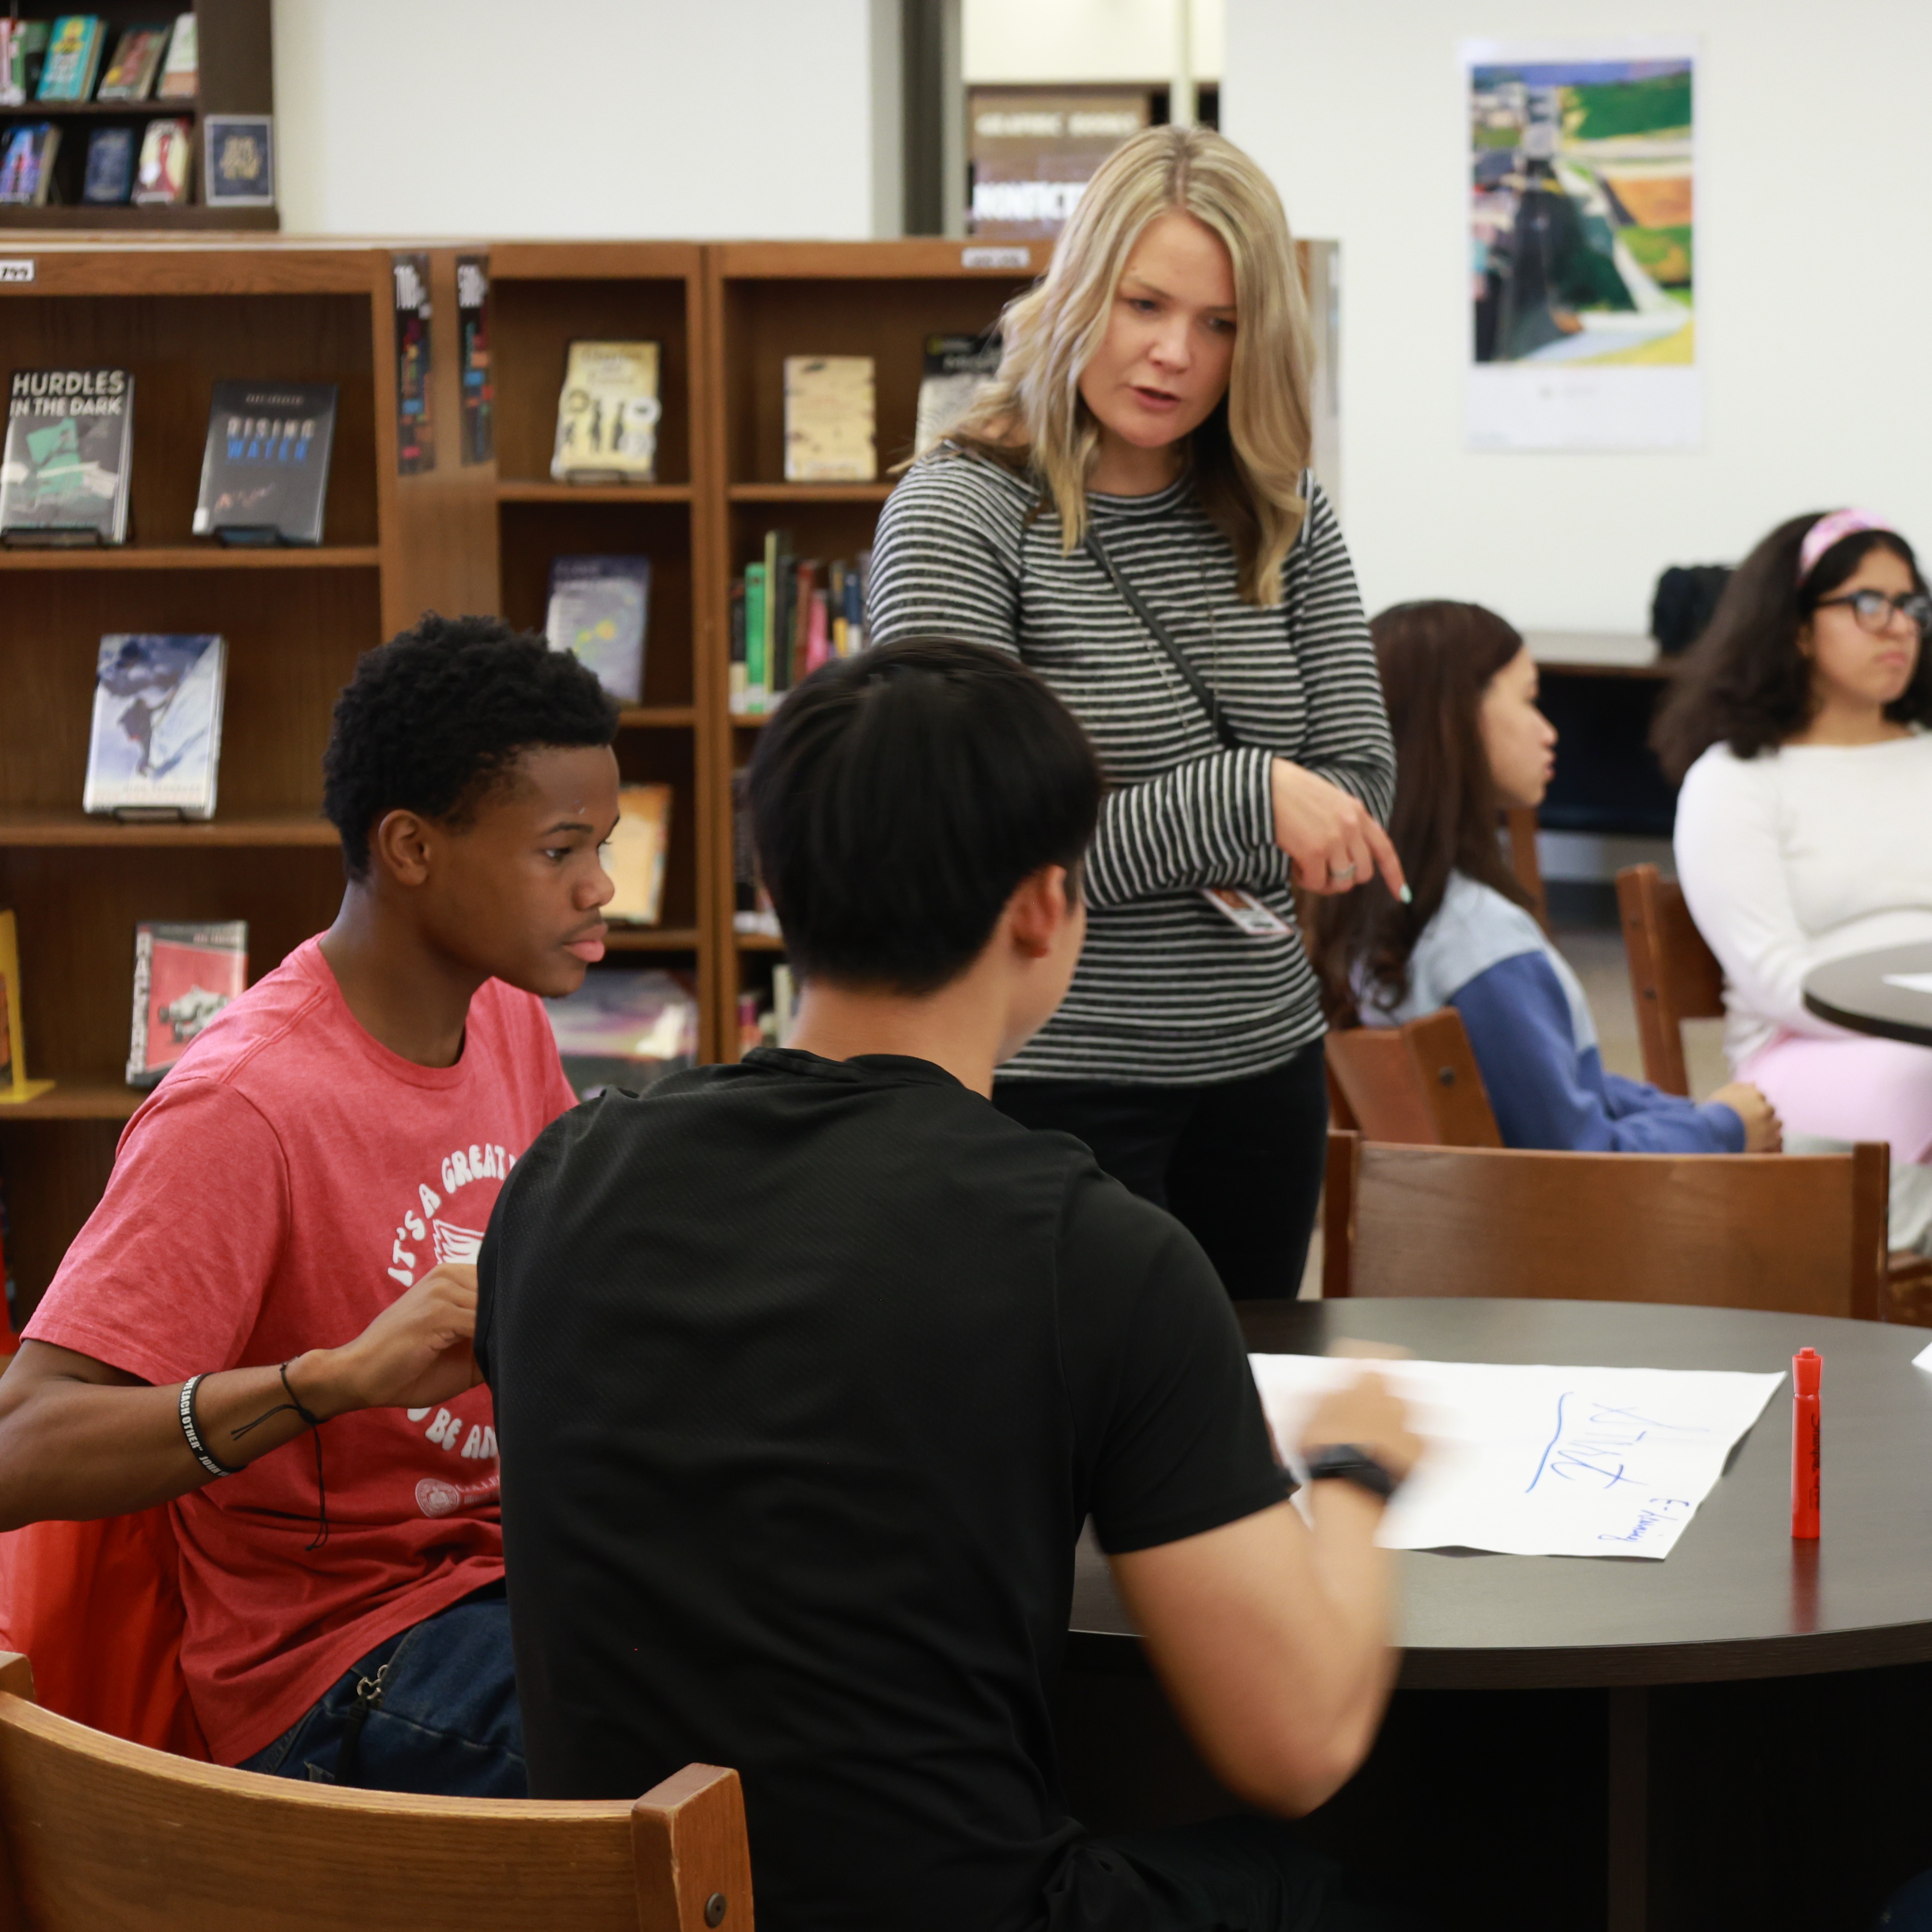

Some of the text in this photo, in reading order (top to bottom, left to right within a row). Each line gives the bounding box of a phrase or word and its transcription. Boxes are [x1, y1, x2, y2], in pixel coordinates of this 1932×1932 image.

[12, 370, 125, 397] HURDLES
[10, 395, 123, 417] IN THE DARK
[388, 1143, 505, 1287] IT'S A GREAT
[180, 1390, 191, 1416] EACH
[199, 1456, 222, 1474] JOHN
[425, 1407, 462, 1451] BE
